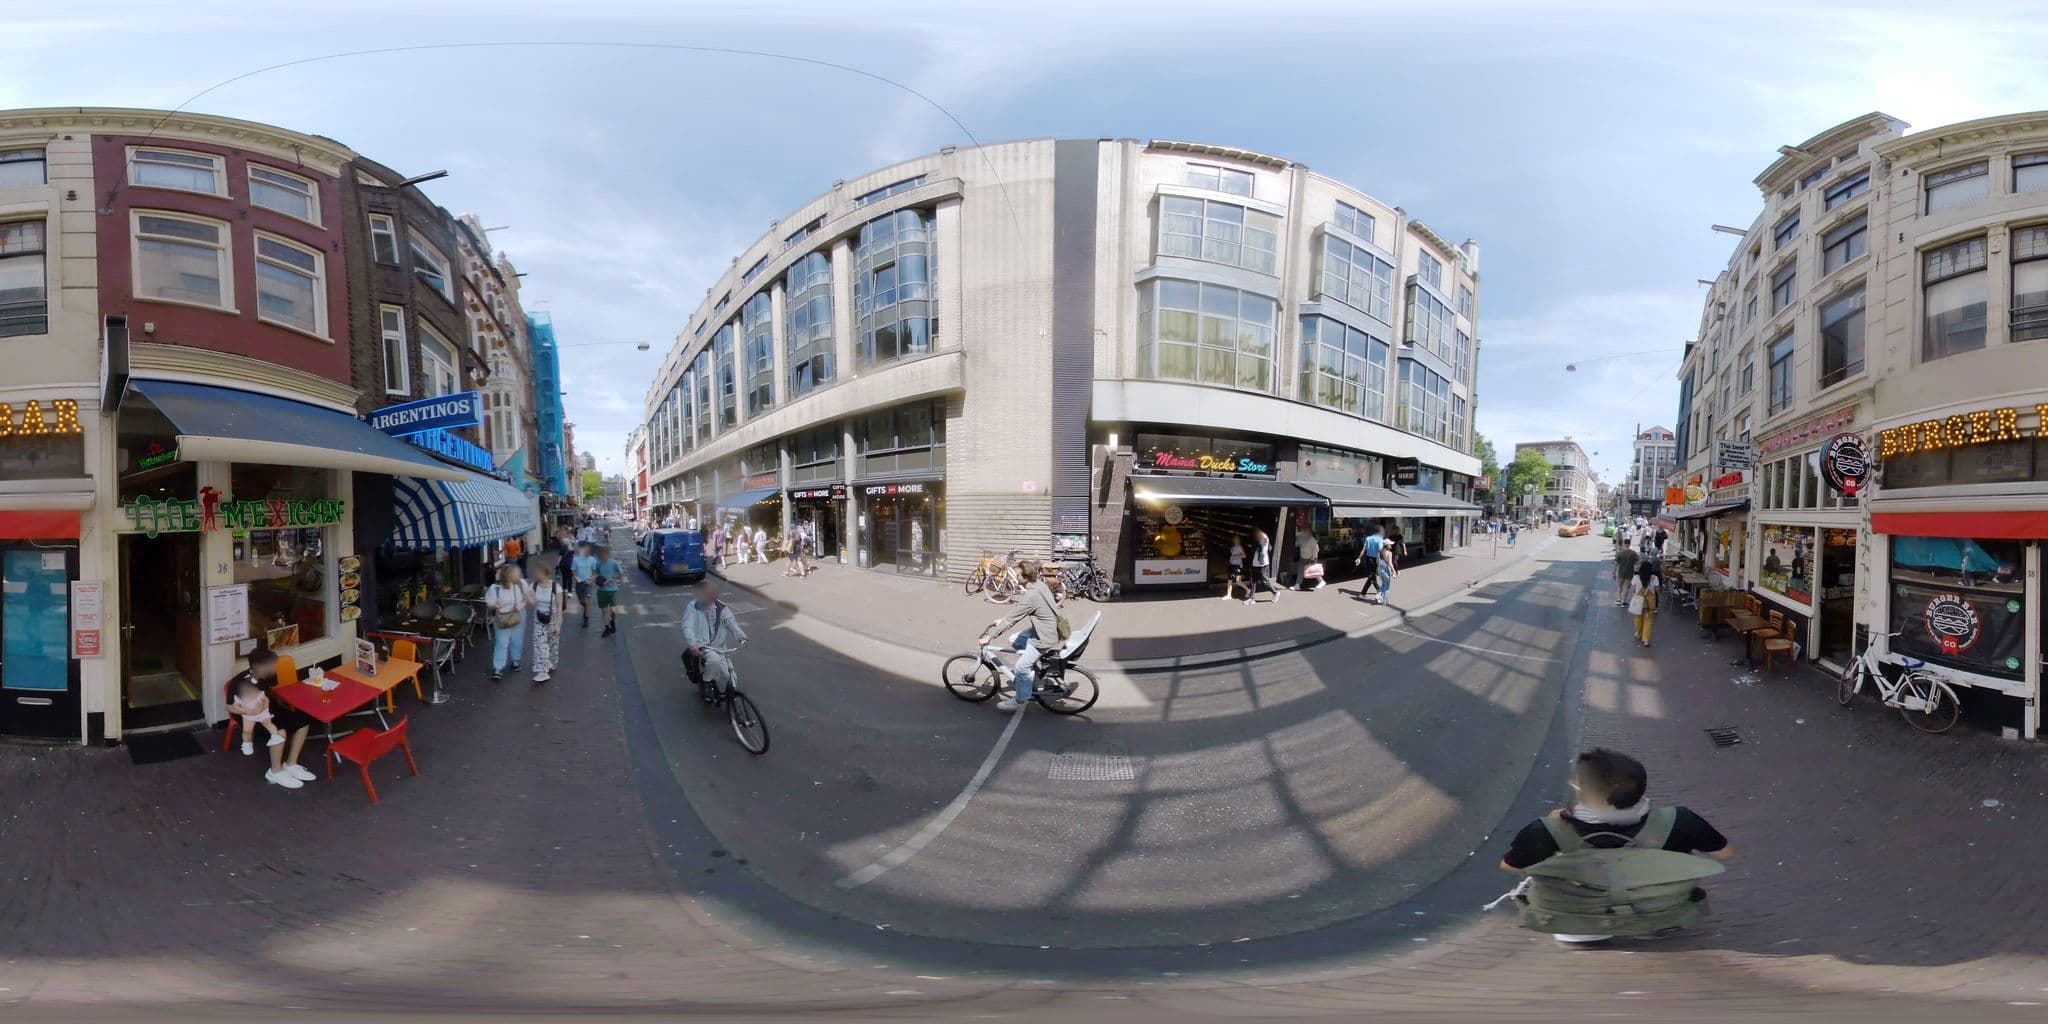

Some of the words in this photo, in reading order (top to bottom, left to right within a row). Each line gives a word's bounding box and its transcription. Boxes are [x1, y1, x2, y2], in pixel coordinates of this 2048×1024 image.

[372, 399, 471, 430] ARGENTINOS
[1880, 407, 2021, 459] BURGER
[1719, 442, 1731, 450] The
[1829, 436, 1859, 457] BURGER
[1156, 452, 1196, 467] Mama
[1200, 455, 1236, 471] Ducks
[1238, 458, 1267, 472] Store
[866, 485, 886, 495] GIFTS
[898, 484, 923, 493] MORE
[124, 495, 197, 539] THE
[219, 498, 345, 529] MEXICAN
[1926, 594, 1960, 617] BURGER
[1962, 604, 1978, 625] BAR
[1943, 640, 1957, 648] CO
